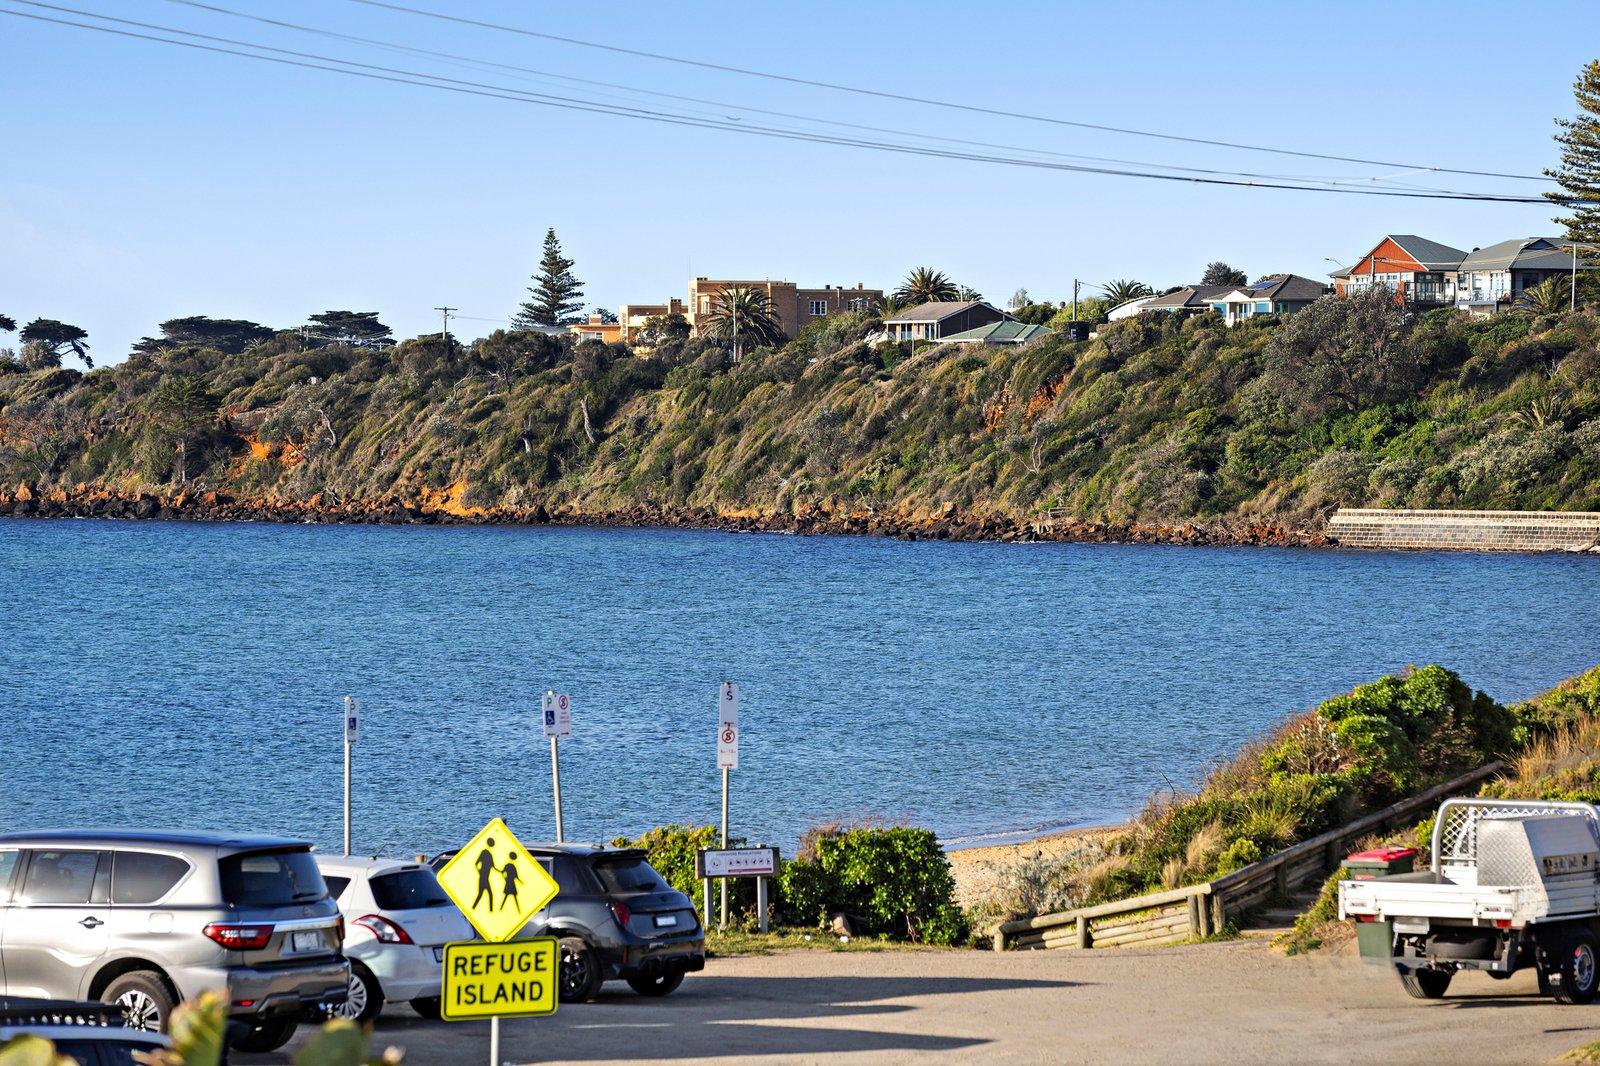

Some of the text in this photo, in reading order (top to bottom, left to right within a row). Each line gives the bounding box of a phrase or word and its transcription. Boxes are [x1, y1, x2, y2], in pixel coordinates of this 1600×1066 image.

[349, 703, 356, 714] P
[453, 951, 547, 977] REFUGE
[456, 981, 544, 1005] ISLAND
